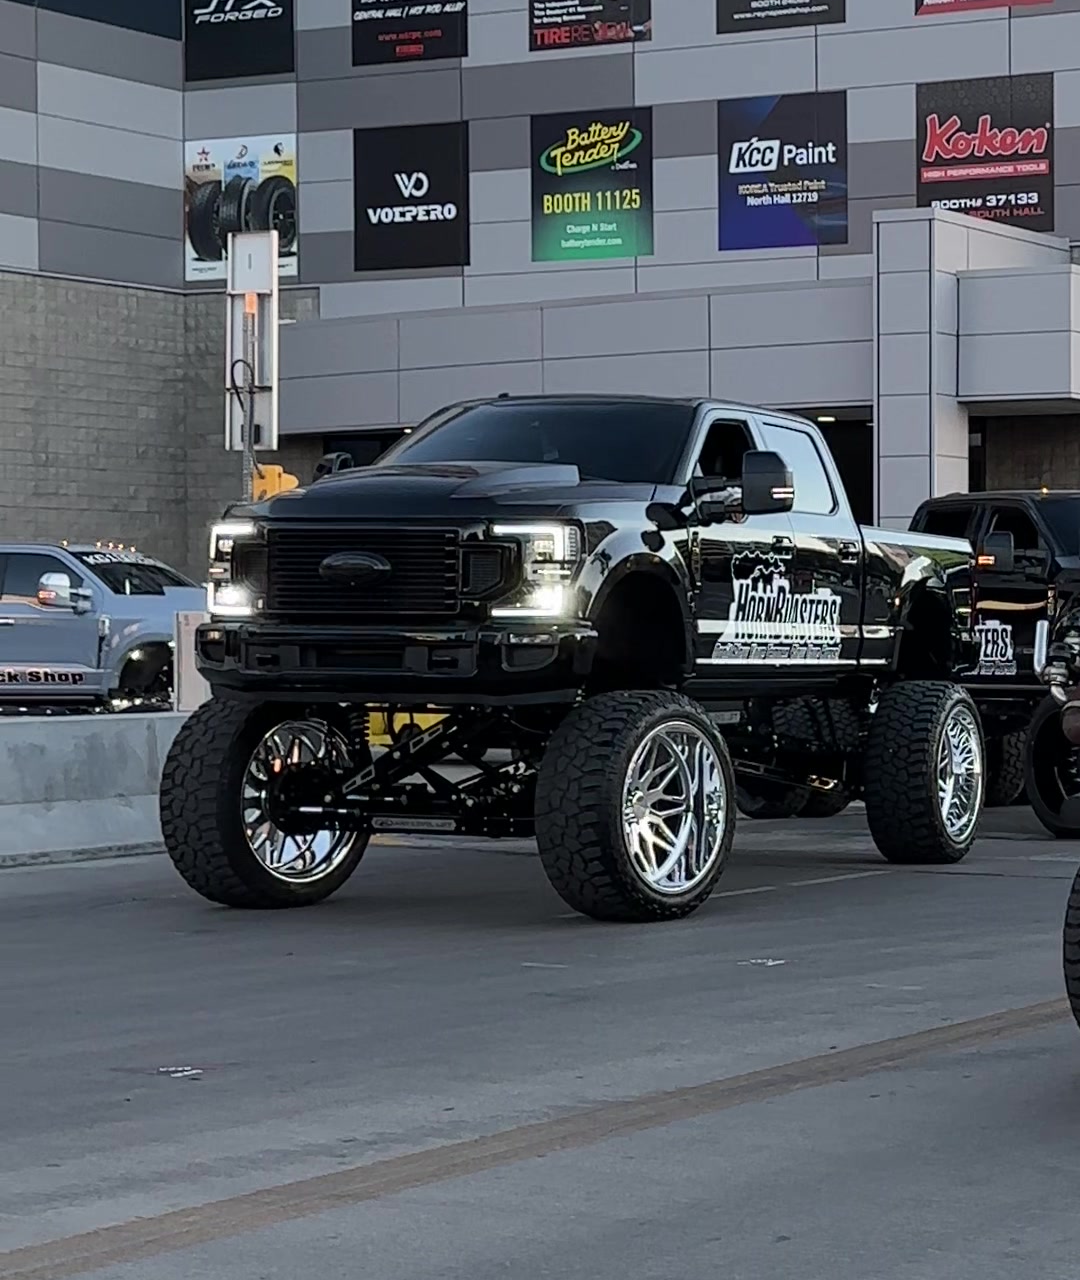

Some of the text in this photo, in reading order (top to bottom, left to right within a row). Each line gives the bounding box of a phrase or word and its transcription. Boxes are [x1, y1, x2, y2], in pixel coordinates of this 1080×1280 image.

[195, 6, 284, 24] FORGED
[566, 120, 630, 151] Battery
[551, 140, 621, 176] Tender
[735, 138, 837, 168] KCC Paint
[924, 170, 945, 179] HIGH
[543, 188, 641, 215] BOOTH 11125
[746, 191, 818, 207] North Hall 12719
[931, 192, 1039, 211] BOOTH# 37133
[28, 670, 84, 685] Shop
